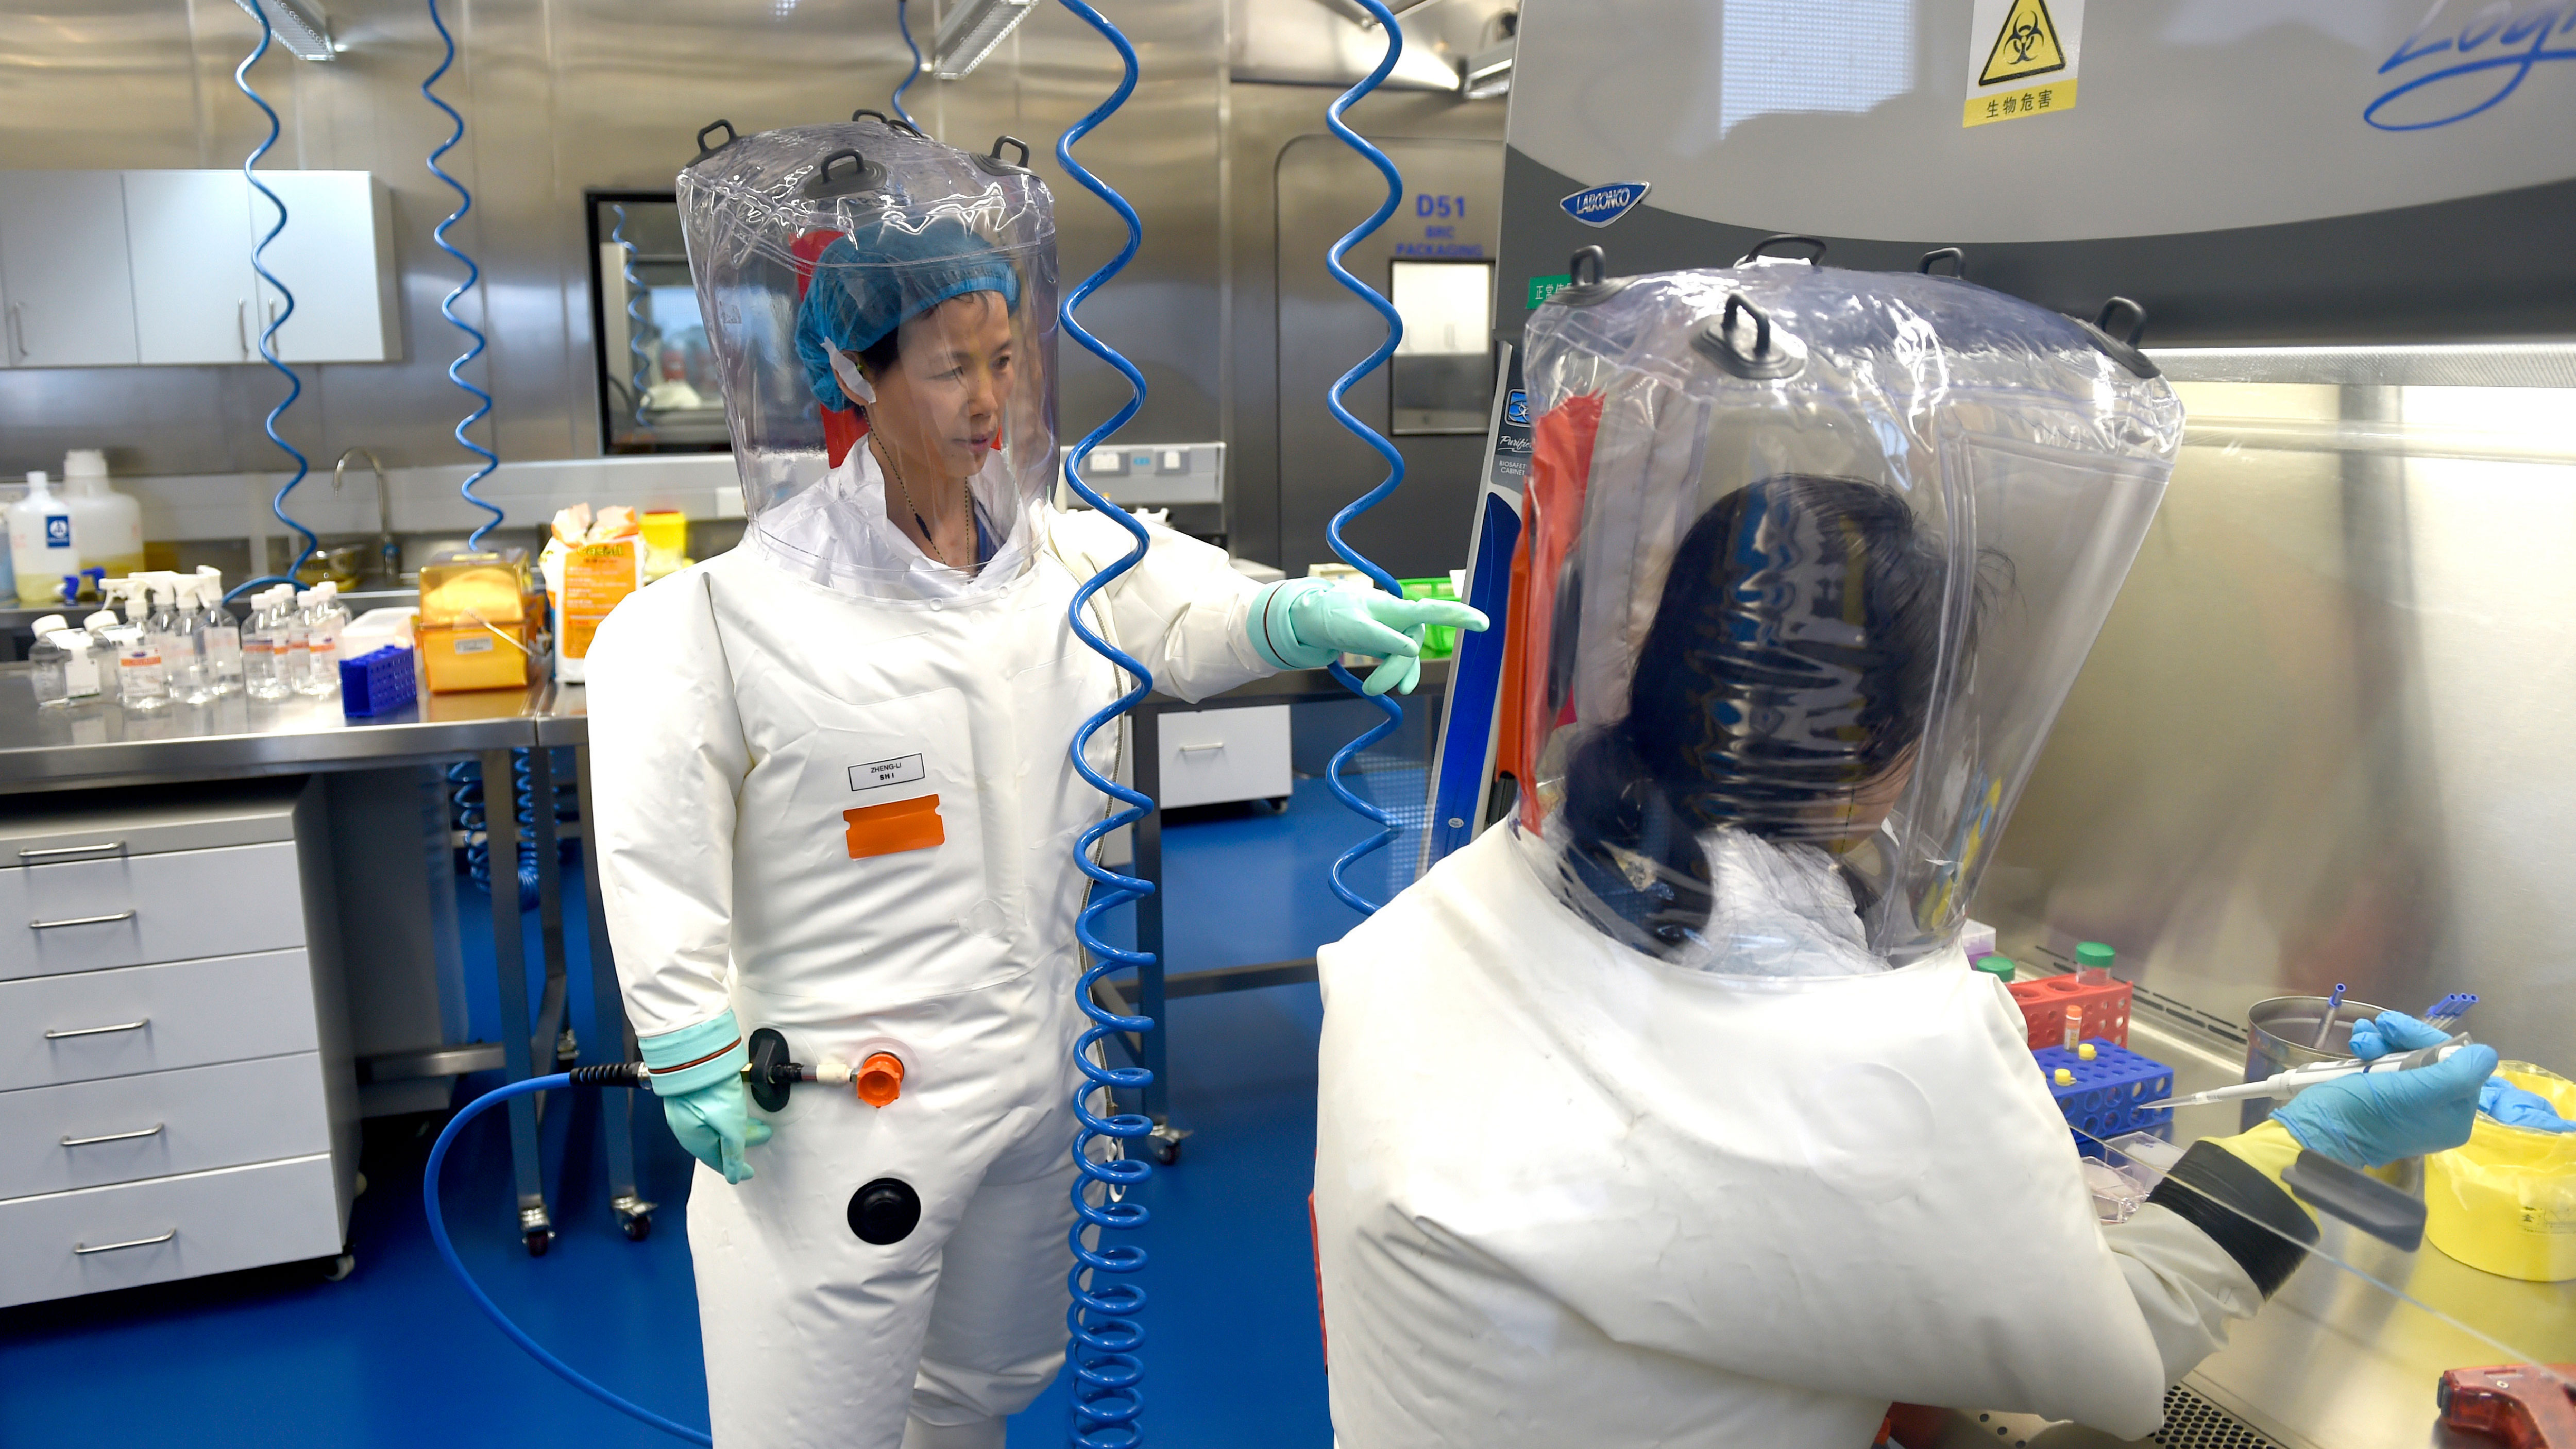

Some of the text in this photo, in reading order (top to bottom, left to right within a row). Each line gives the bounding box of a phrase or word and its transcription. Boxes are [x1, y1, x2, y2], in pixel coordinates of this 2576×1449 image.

[1986, 89, 2053, 118] 生物危害
[1417, 194, 1464, 217] D51
[1576, 187, 1631, 215] LABCONCO
[1501, 467, 1525, 475] CABINET
[871, 762, 902, 773] ZHENG-LI
